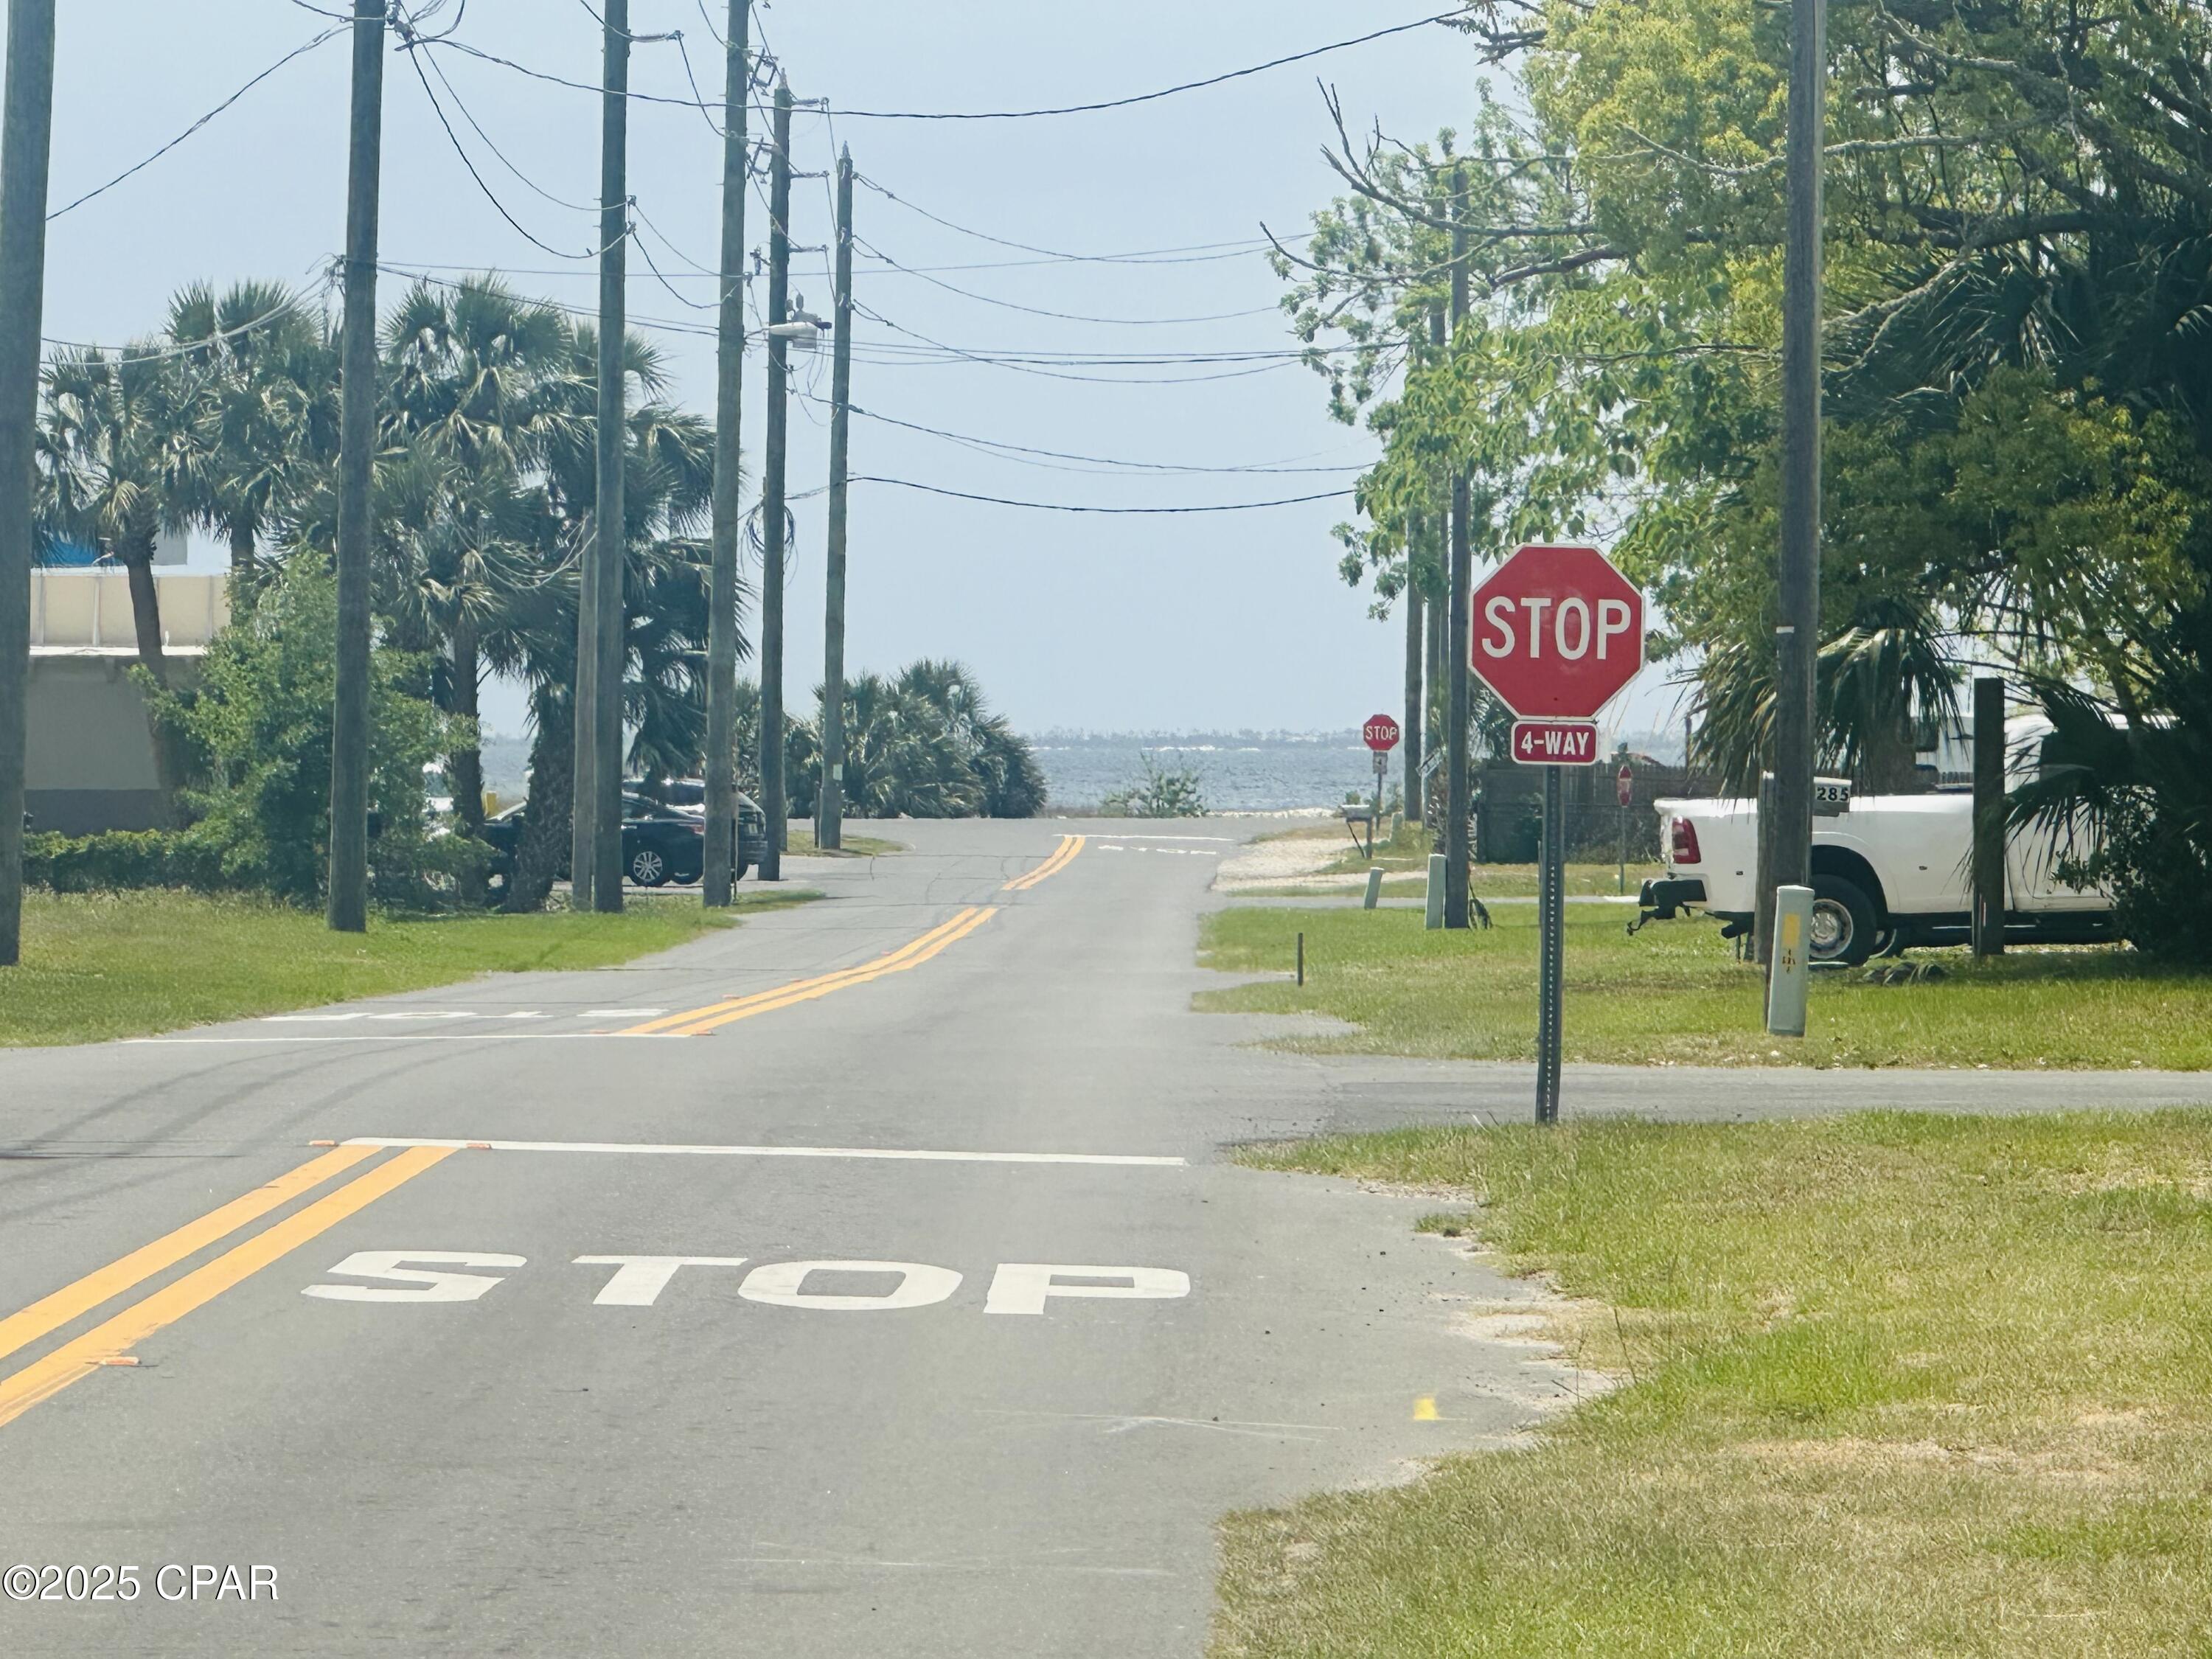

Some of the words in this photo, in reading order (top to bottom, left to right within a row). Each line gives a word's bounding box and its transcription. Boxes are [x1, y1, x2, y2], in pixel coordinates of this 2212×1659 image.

[1481, 596, 1632, 660] STOP
[1365, 725, 1398, 741] STOP
[1520, 731, 1589, 756] 4-WAY
[1816, 786, 1848, 801] 285
[301, 1250, 1192, 1315] STOP
